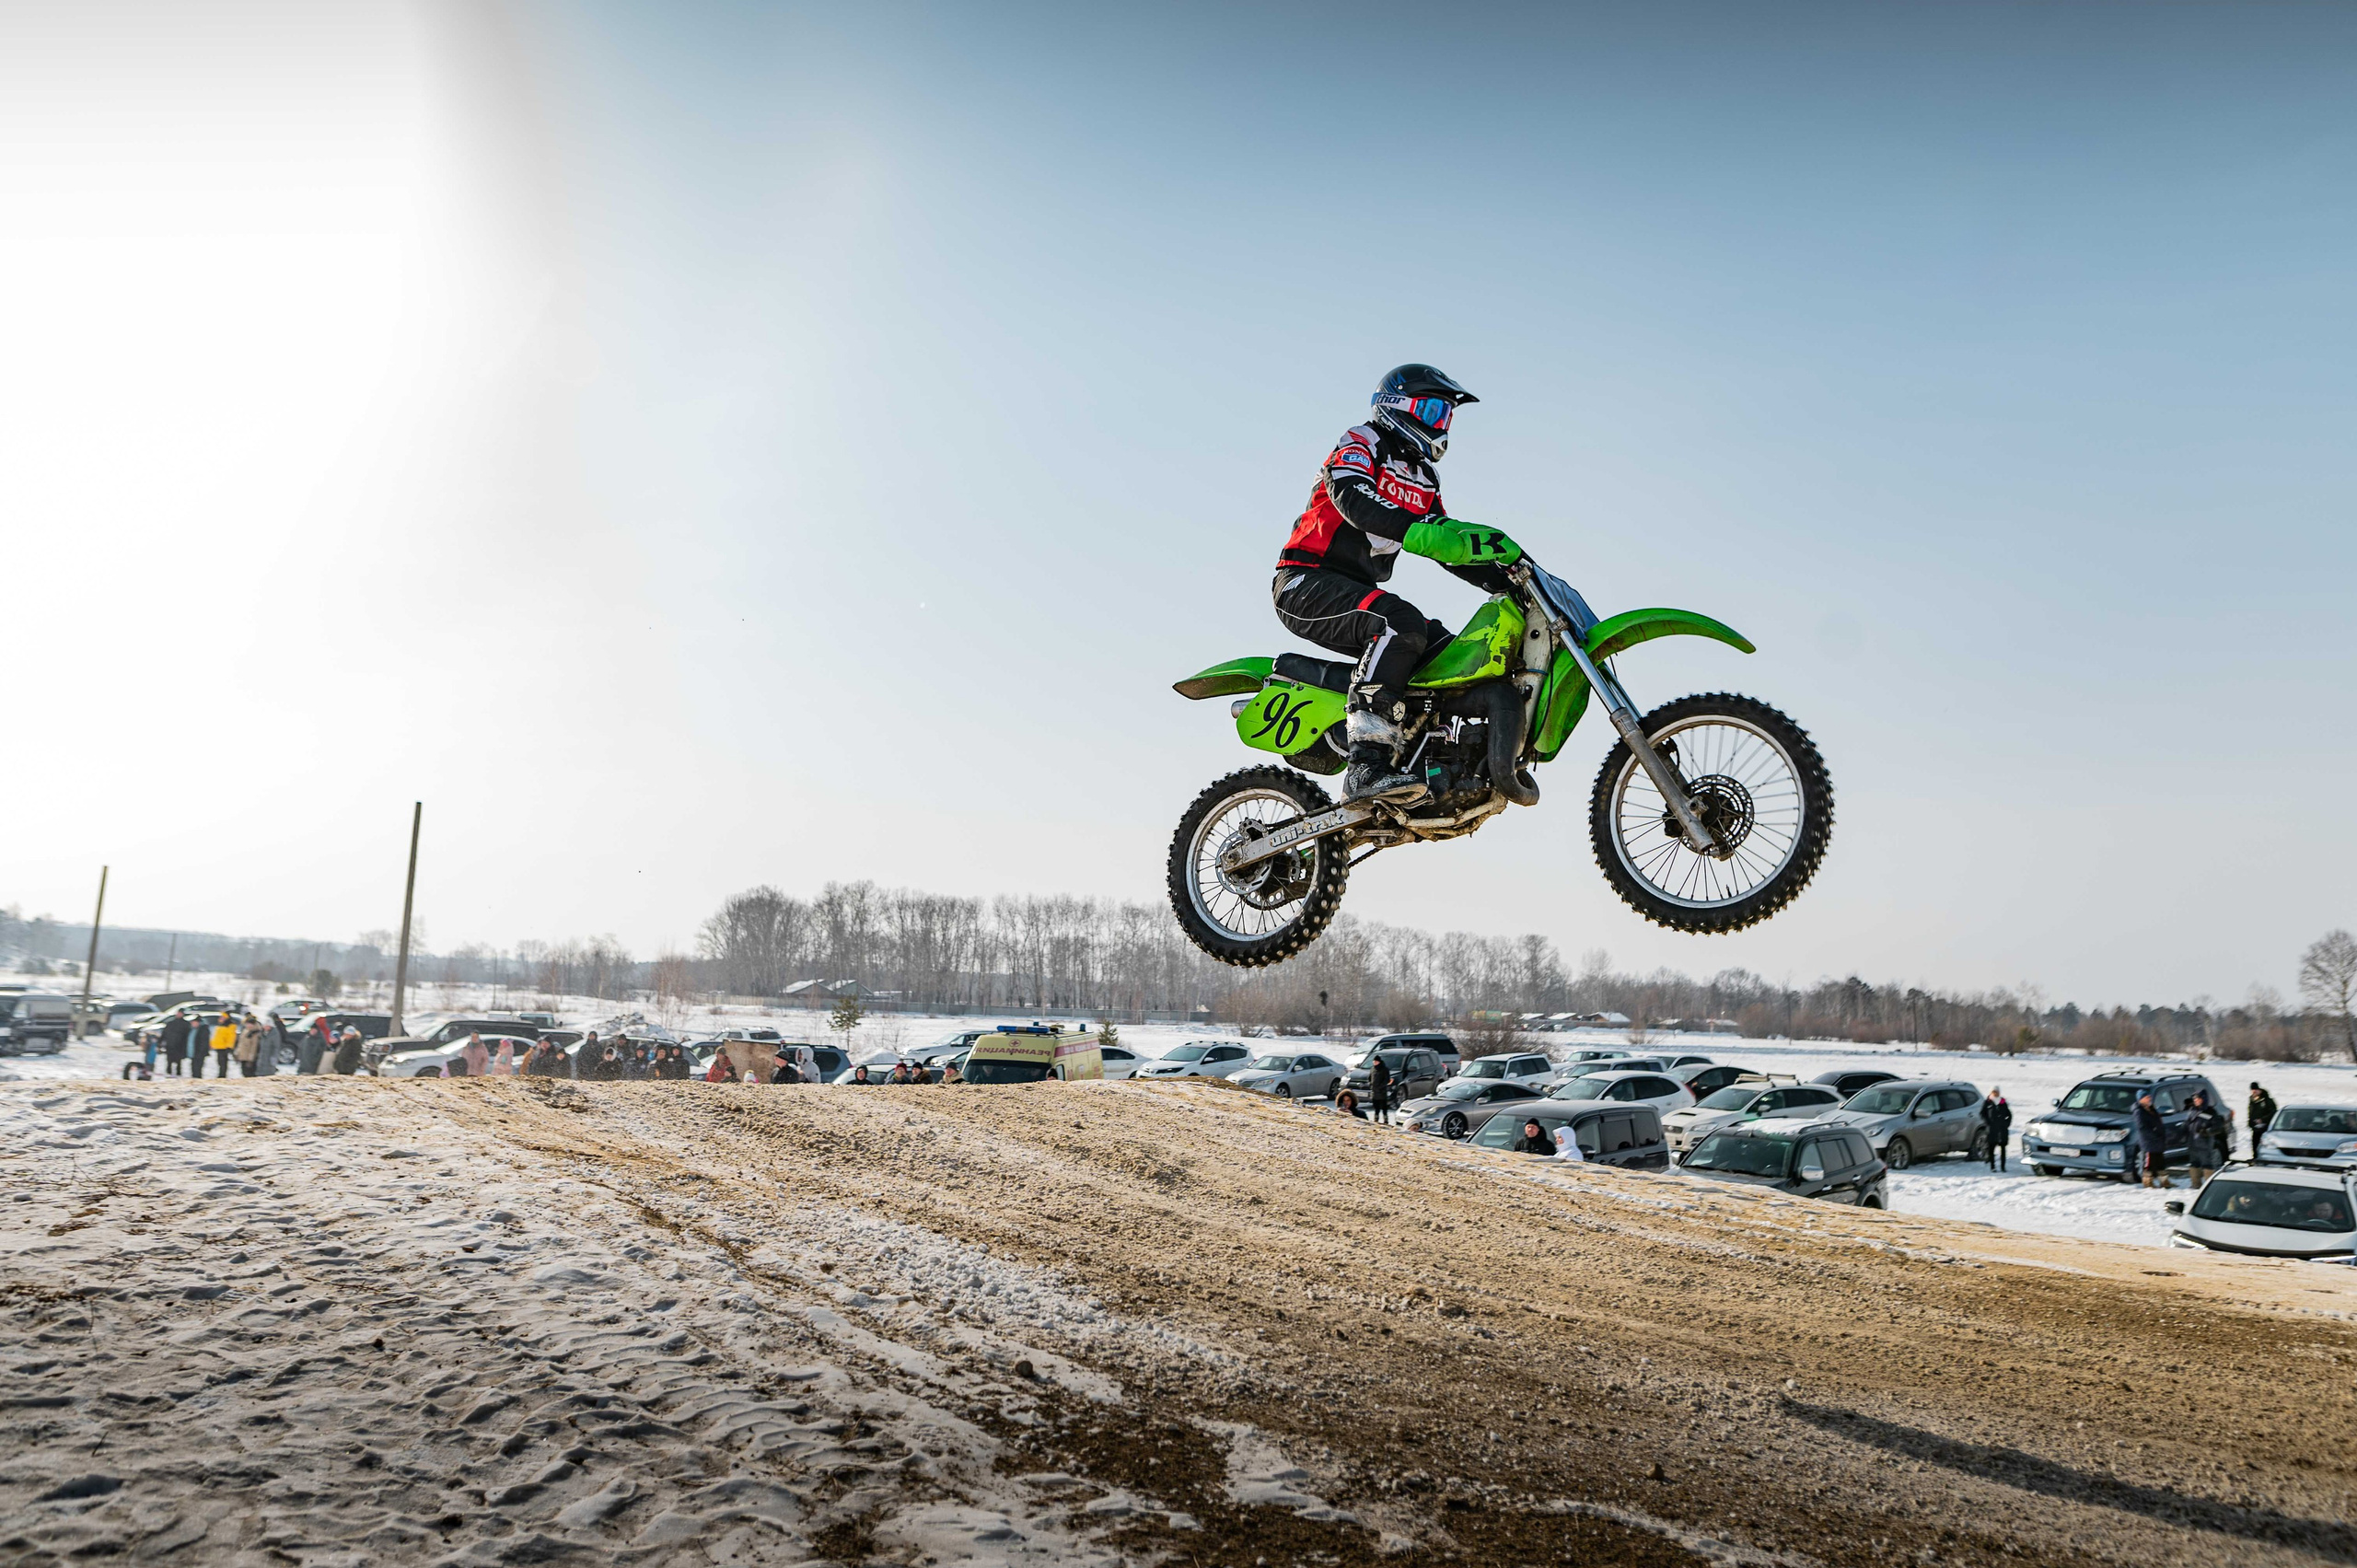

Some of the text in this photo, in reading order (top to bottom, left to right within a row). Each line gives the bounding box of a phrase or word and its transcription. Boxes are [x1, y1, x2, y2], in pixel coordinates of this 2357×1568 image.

[1376, 394, 1406, 404] thor
[1349, 455, 1370, 467] GAS
[1469, 532, 1507, 555] K
[1250, 692, 1313, 748] 96
